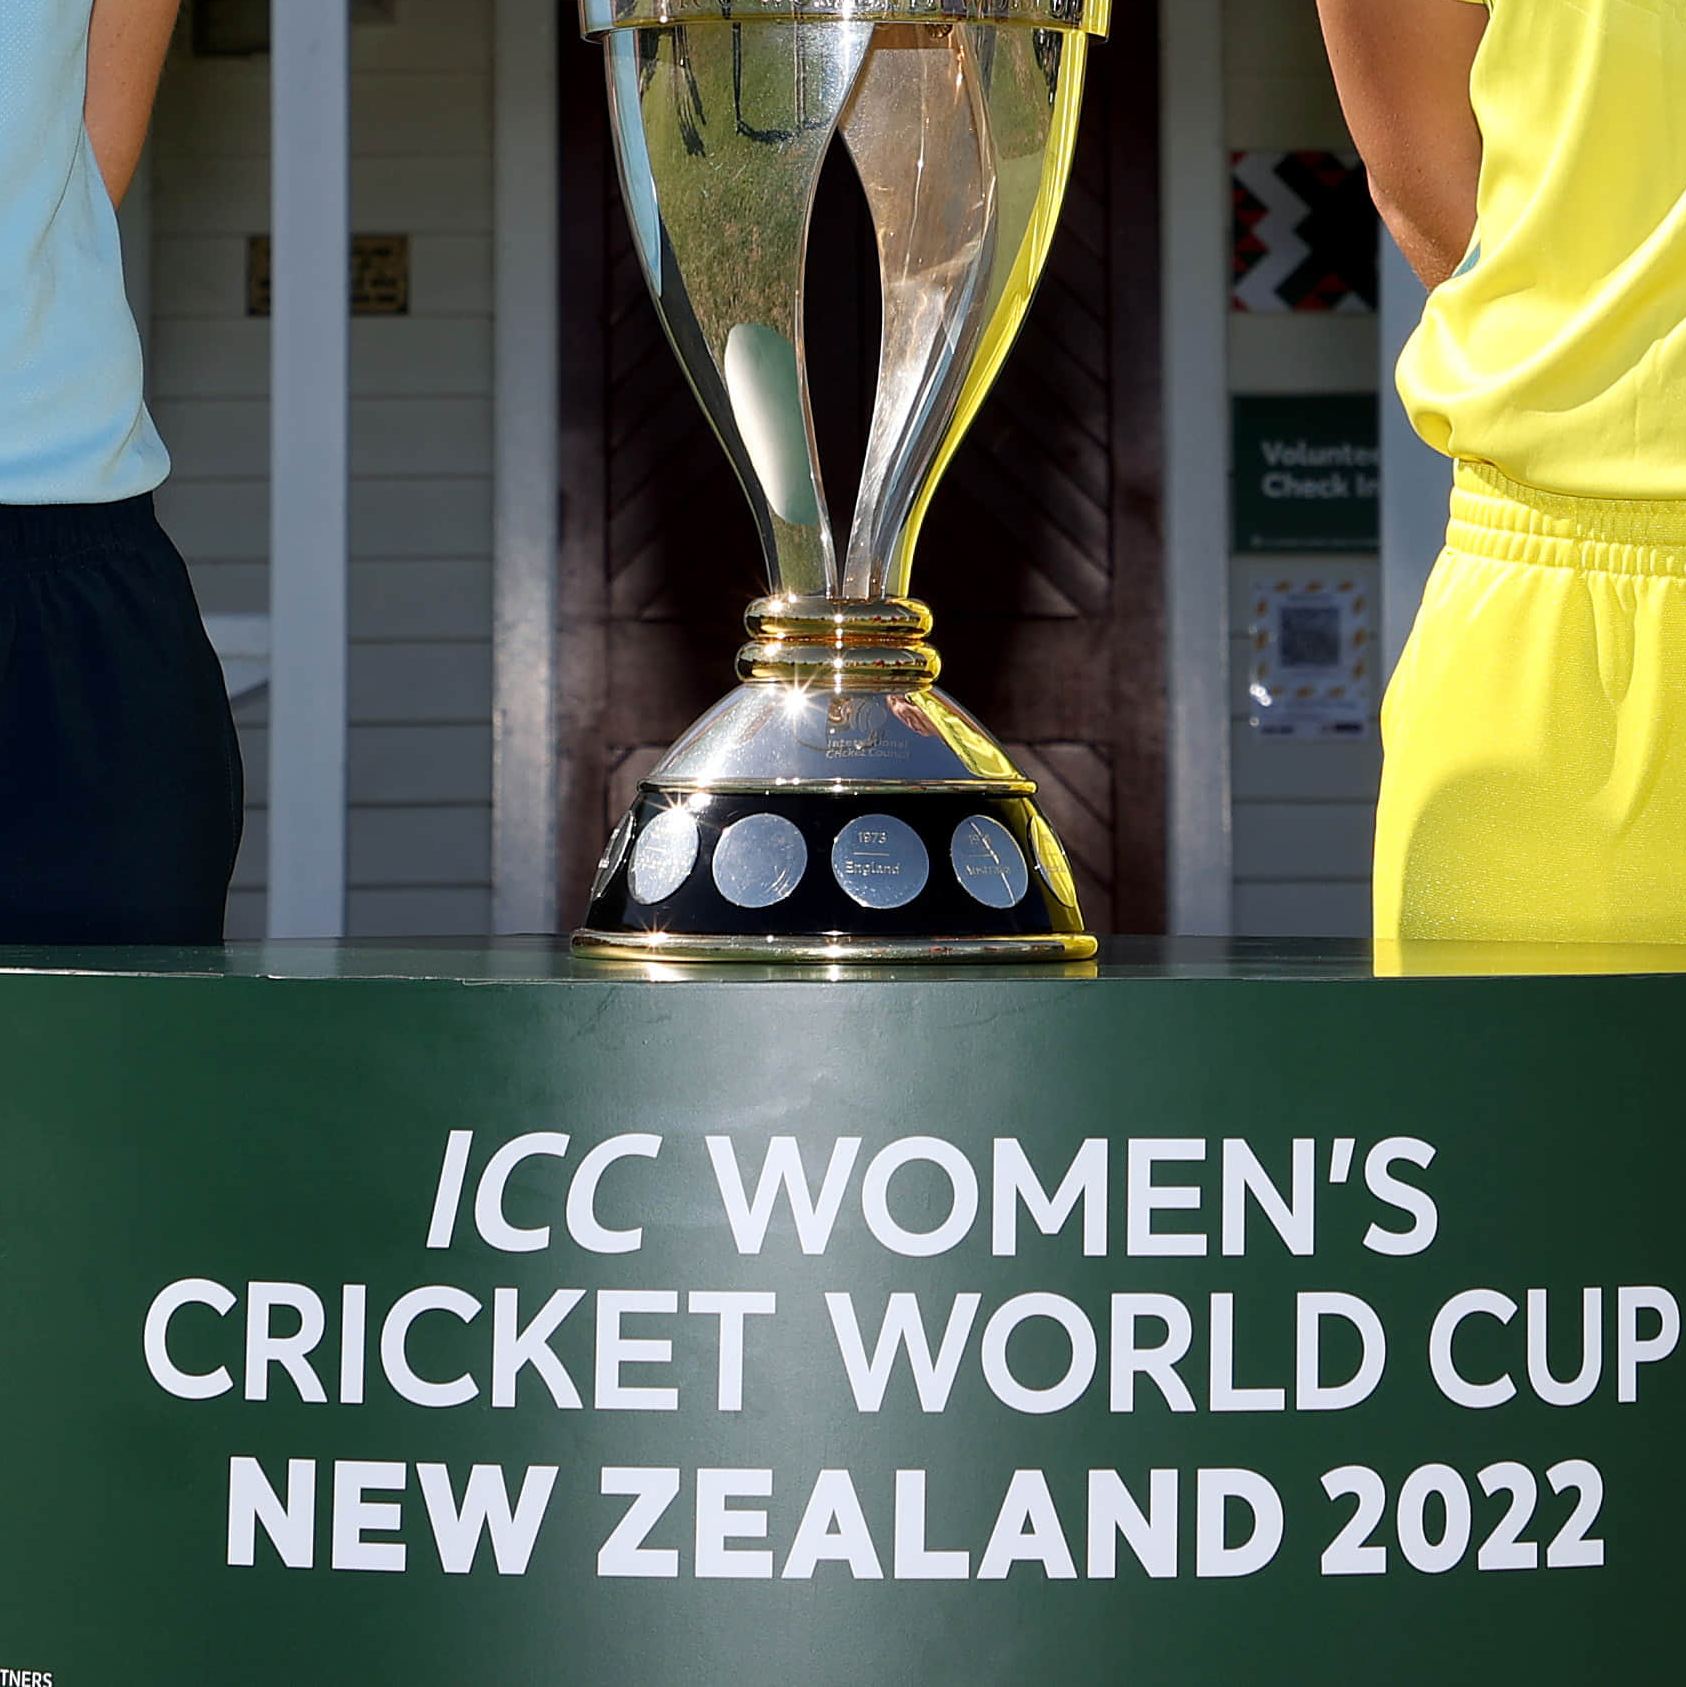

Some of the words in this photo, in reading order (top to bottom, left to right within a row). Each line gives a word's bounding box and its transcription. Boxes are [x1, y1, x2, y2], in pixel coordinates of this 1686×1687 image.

[1261, 471, 1350, 499] Check
[845, 859, 901, 877] England
[857, 831, 888, 844] 1973
[426, 1129, 663, 1254] ICC
[707, 1134, 1439, 1257] WOMEN'S
[143, 1277, 778, 1412] CRICKET
[823, 1289, 1386, 1414] WORLD
[1429, 1286, 1681, 1409] CUP
[227, 1456, 560, 1575] NEW
[597, 1466, 1285, 1580] ZEALAND
[1320, 1459, 1605, 1575] 2022
